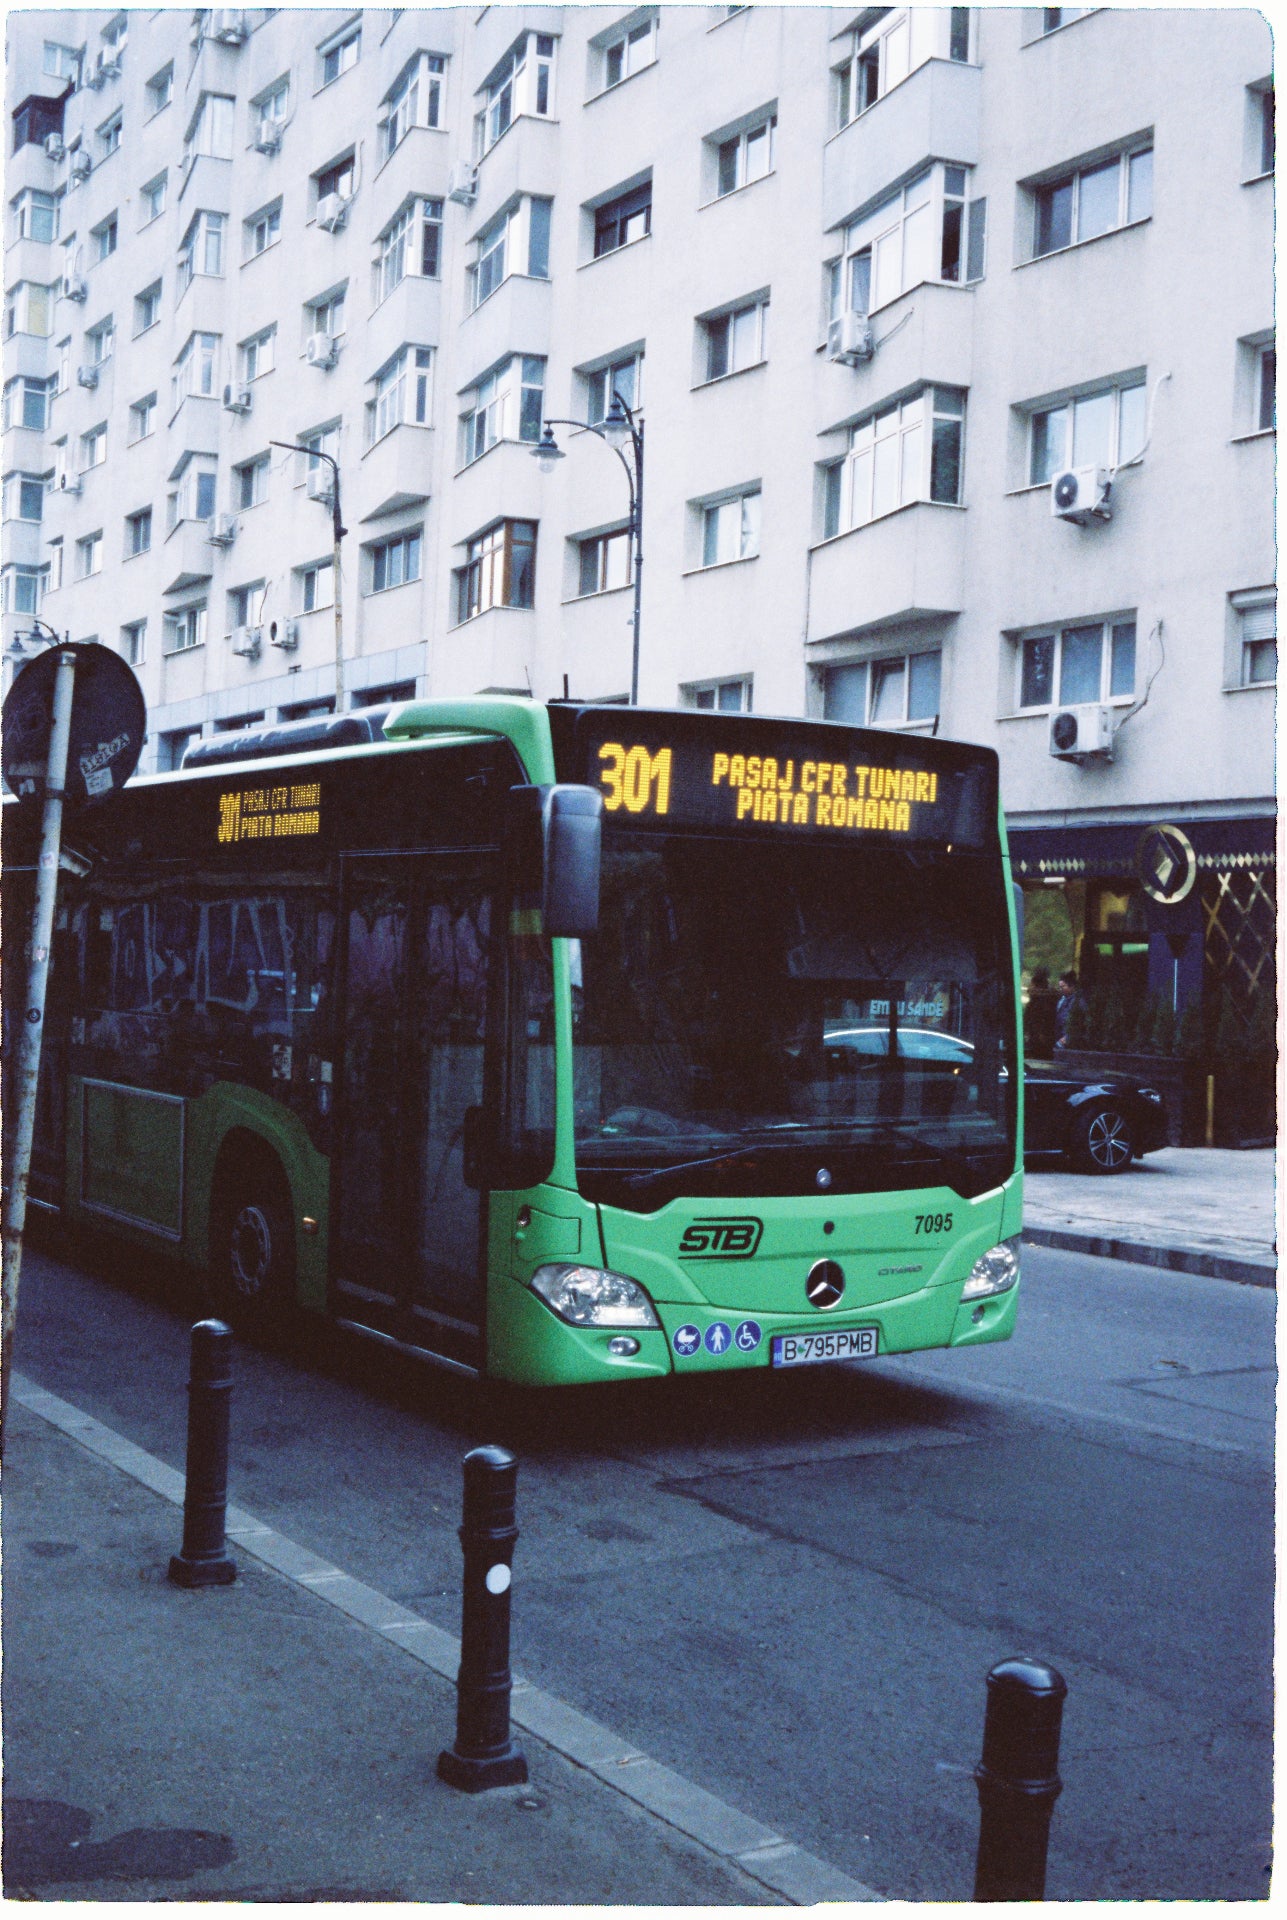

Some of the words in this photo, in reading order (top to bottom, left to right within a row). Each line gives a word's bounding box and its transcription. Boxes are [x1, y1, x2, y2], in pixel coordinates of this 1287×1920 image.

[599, 742, 672, 814] 301
[711, 753, 794, 789] PASAJ
[801, 761, 847, 794] CFR
[855, 766, 938, 803] TUNARI
[218, 792, 241, 842] 301
[736, 788, 808, 824] PIATA
[816, 796, 911, 832] ROMANA
[678, 1222, 756, 1253] STB
[914, 1213, 954, 1235] 7095
